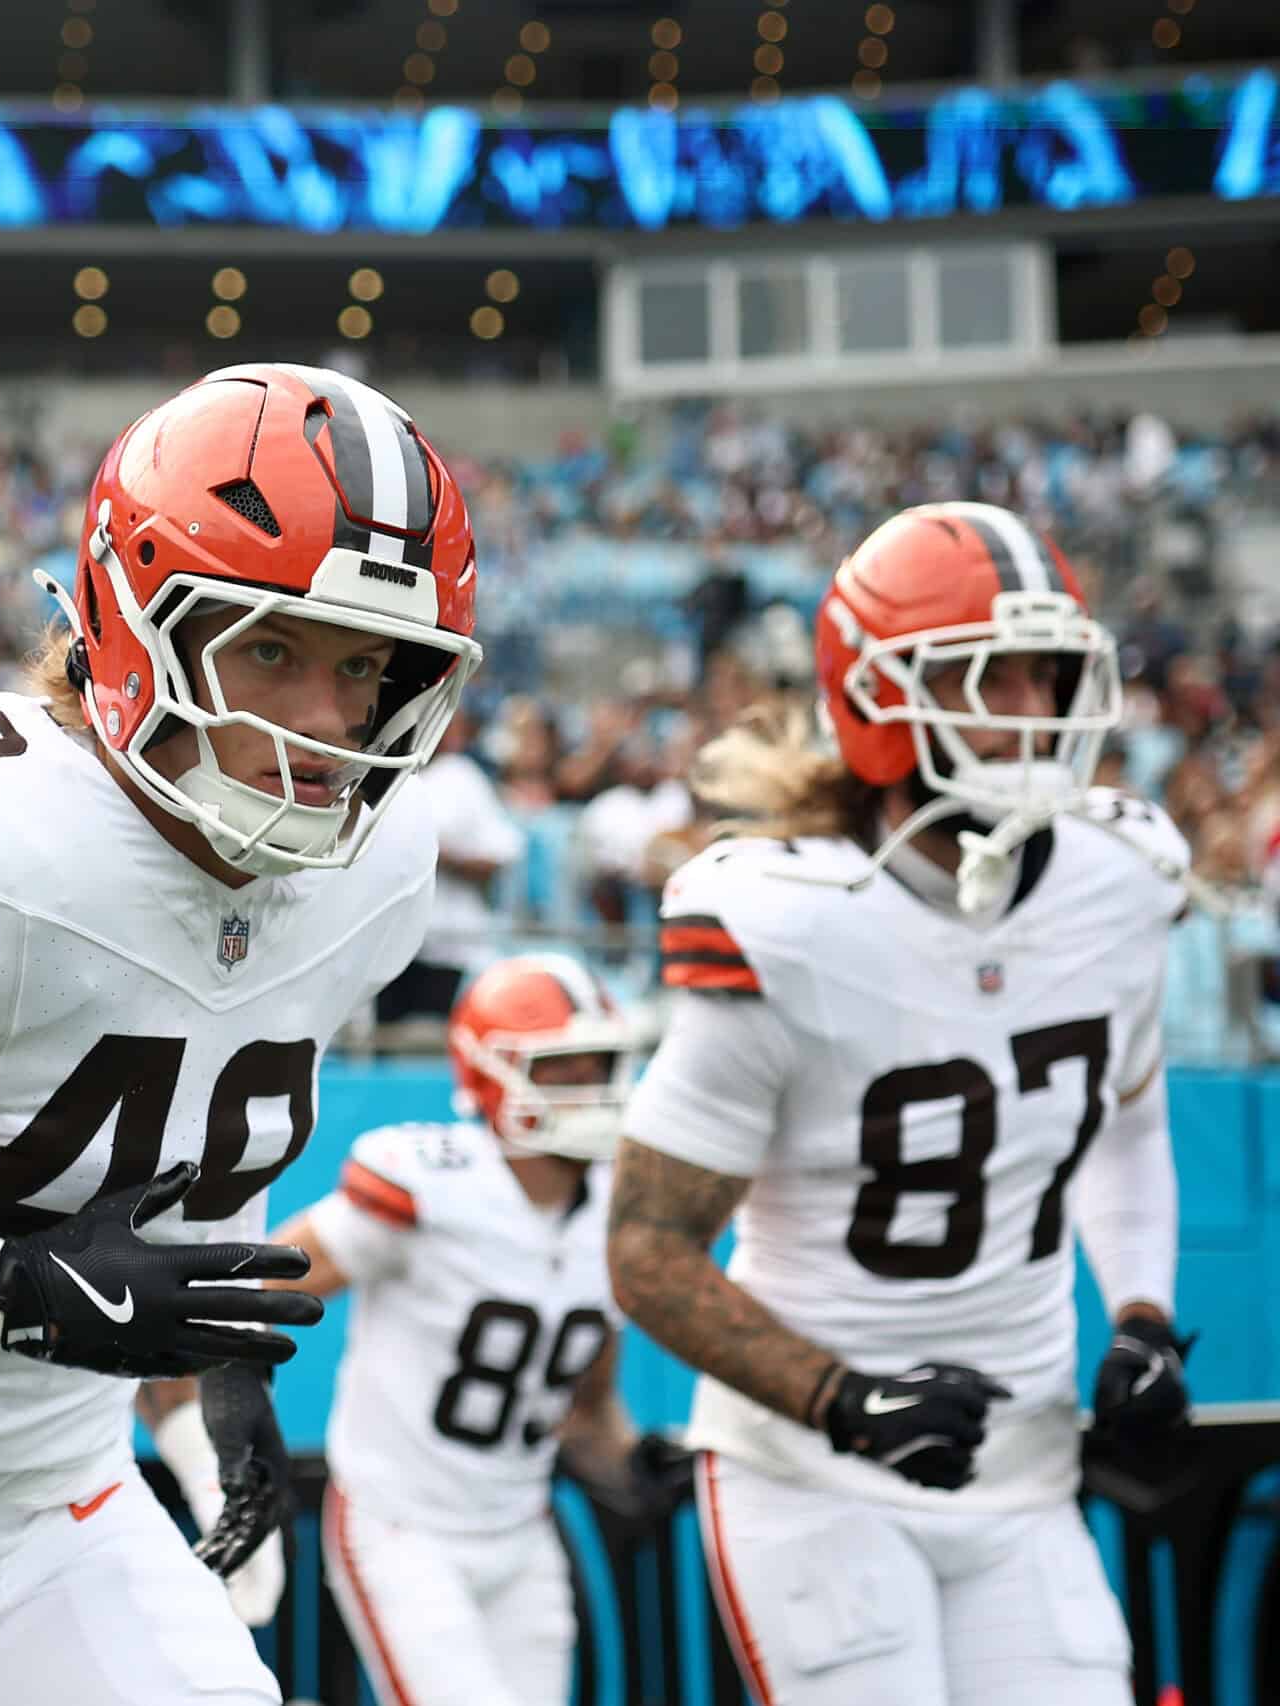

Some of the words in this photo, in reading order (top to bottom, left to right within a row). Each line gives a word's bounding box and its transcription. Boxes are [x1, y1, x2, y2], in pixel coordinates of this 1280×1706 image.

[359, 559, 418, 588] BROWNS
[844, 1015, 1109, 1278] 87
[434, 1300, 609, 1448] 89
